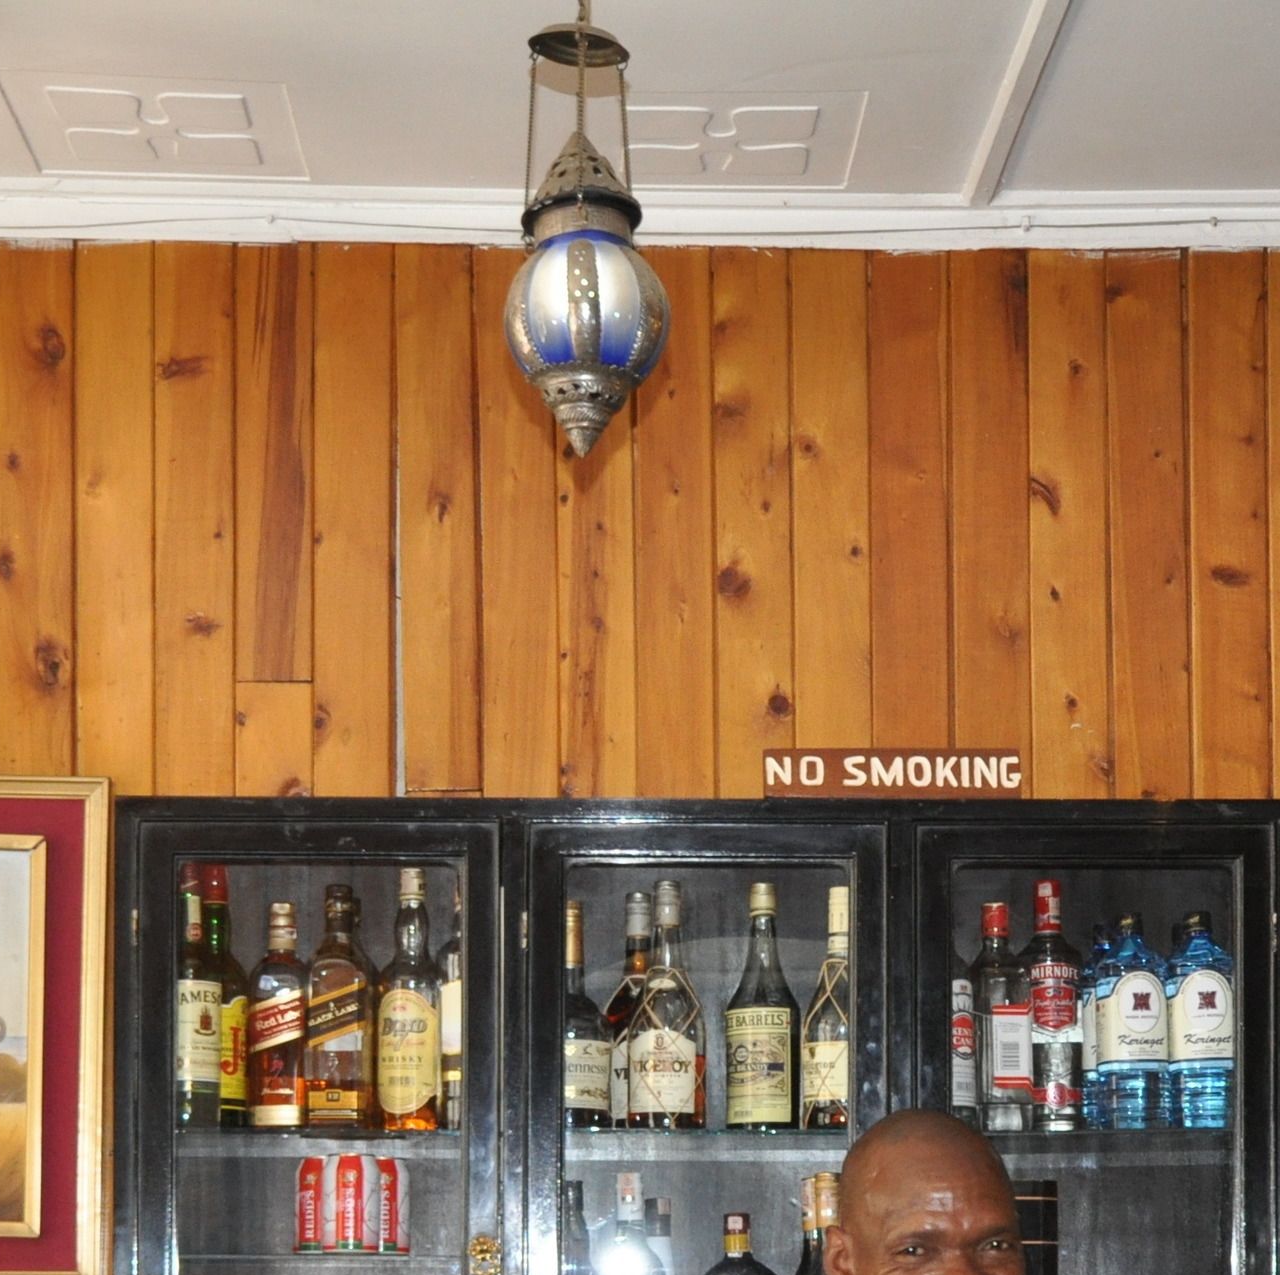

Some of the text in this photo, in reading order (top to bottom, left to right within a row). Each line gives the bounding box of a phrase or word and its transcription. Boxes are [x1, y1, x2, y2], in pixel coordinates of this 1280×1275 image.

[765, 755, 1022, 789] NO SMOKING
[1031, 966, 1079, 979] MIRNOFF
[180, 990, 220, 1005] AMES
[735, 1014, 784, 1027] BARRELS
[1117, 1034, 1166, 1048] Keringet
[1183, 1033, 1232, 1047] Keringet
